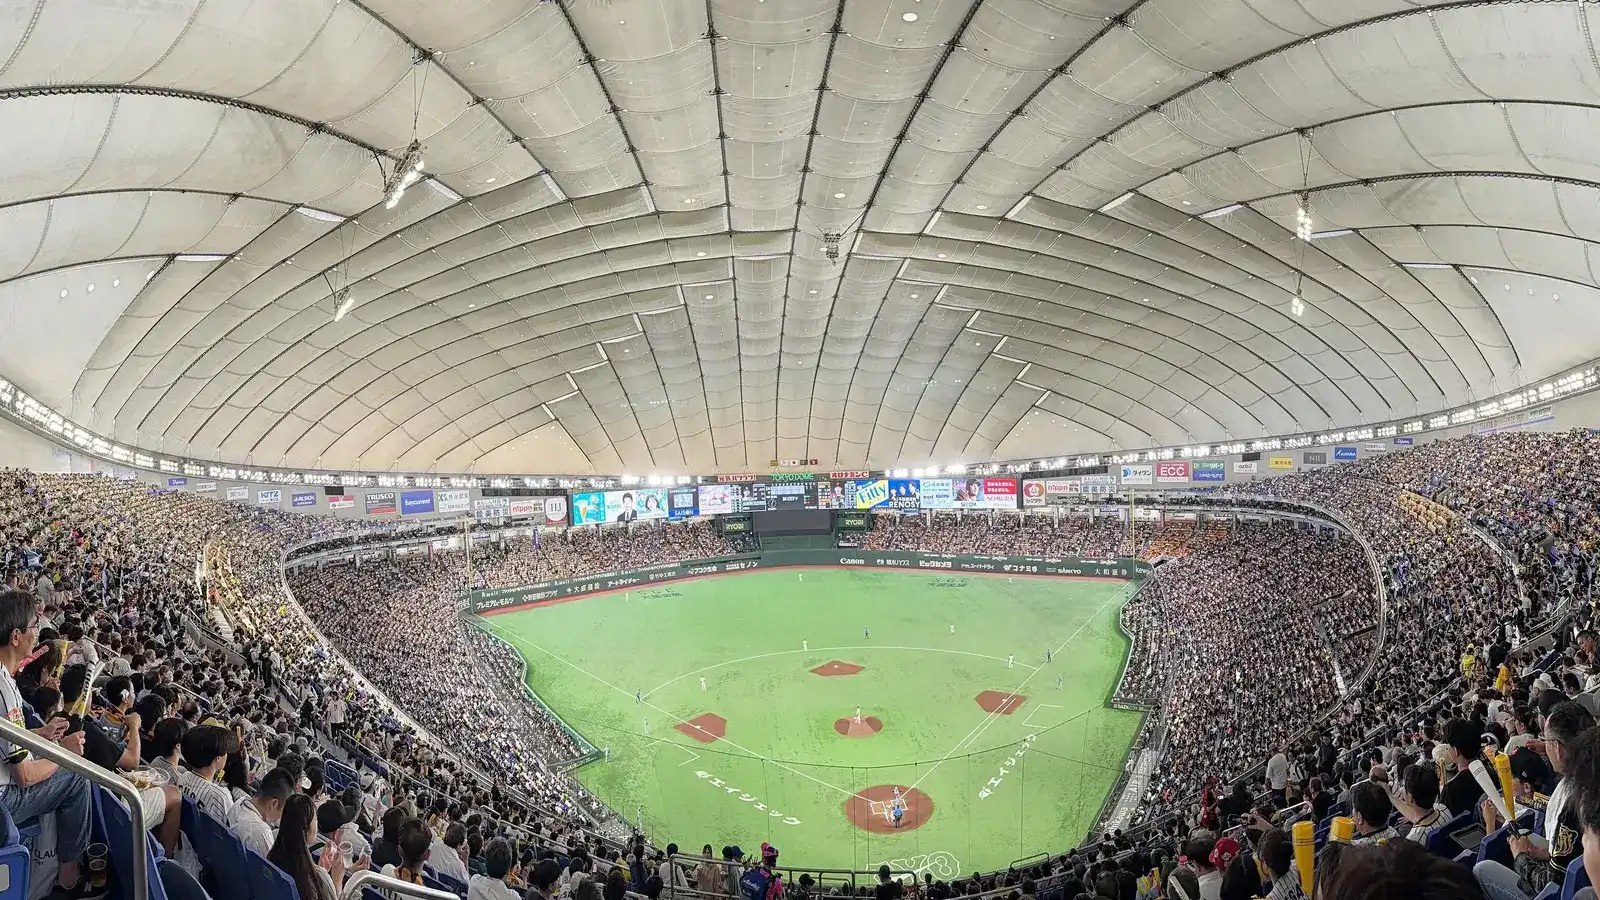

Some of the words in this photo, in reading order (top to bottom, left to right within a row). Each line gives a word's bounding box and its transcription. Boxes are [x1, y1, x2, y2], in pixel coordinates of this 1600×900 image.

[1160, 466, 1185, 476] ECC
[771, 473, 795, 481] TOKYO
[1048, 484, 1068, 492] nippn
[260, 491, 279, 499] KITZ
[366, 492, 394, 501] TRUSCO
[859, 484, 887, 504] Fitty
[512, 505, 532, 513] nippn
[840, 557, 865, 565] Canon
[919, 560, 952, 568] ビックカメラ
[1094, 567, 1128, 576] 大和証券
[986, 733, 1037, 788] エイジェック
[708, 777, 802, 826] エイジェック
